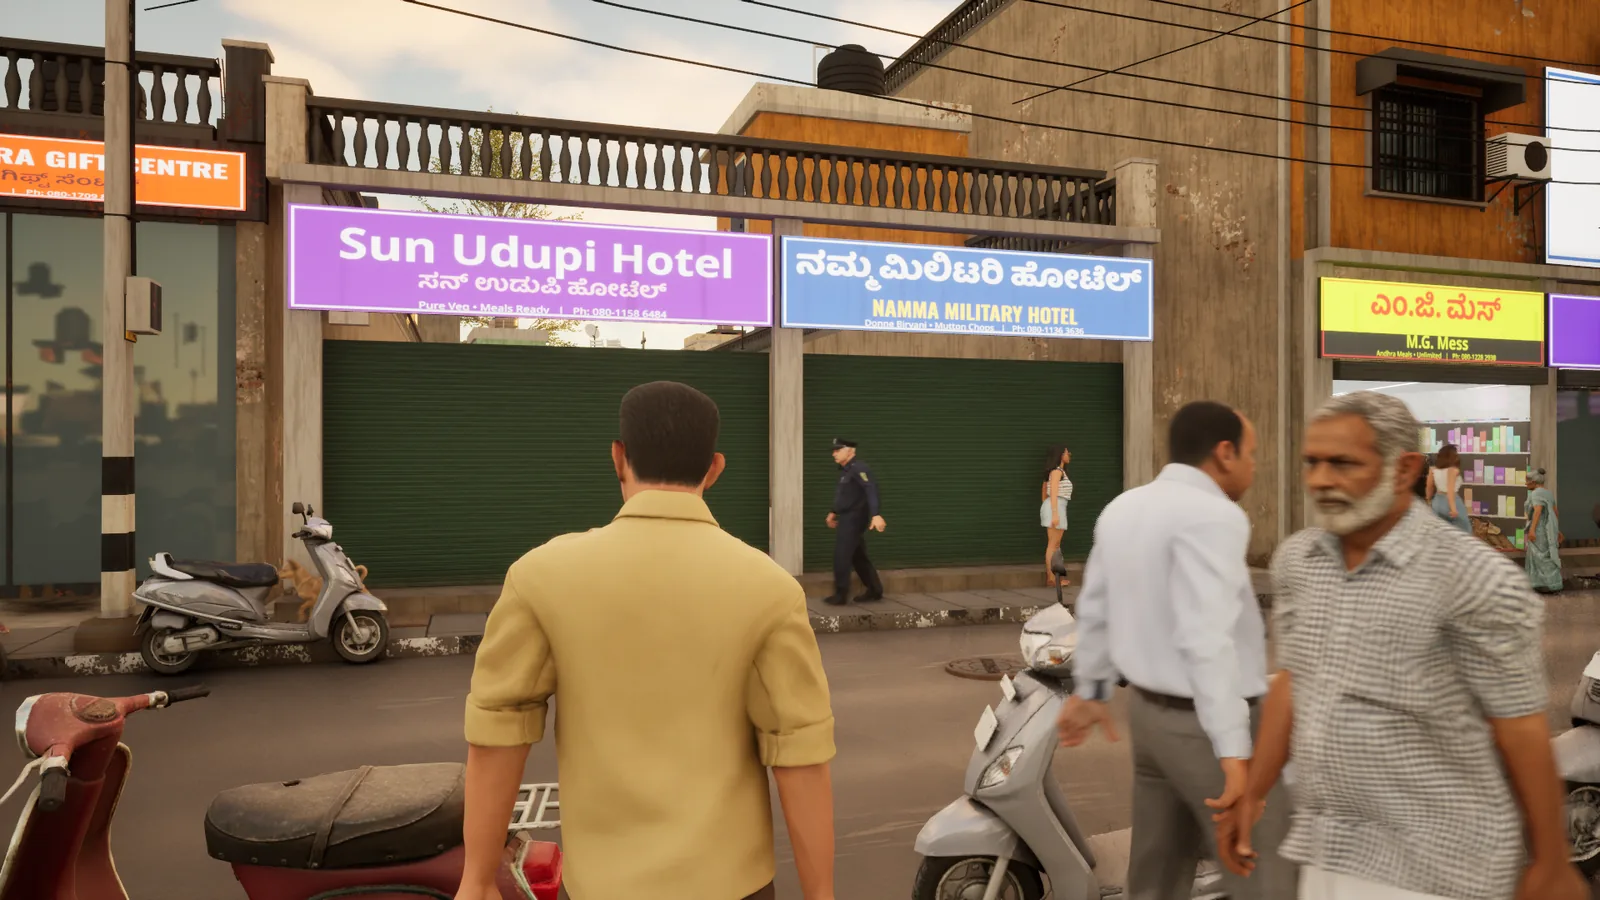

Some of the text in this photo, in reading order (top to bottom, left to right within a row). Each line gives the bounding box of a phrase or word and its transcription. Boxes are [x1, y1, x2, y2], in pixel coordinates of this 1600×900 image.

[46, 151, 104, 171] GIFT
[135, 157, 229, 180] ENTRE
[338, 226, 733, 280] Sun Udupi Hotel
[418, 271, 668, 299] ಸನ್ ಉಡುಪಿ ಹೋಟೆಲ್
[796, 249, 1142, 293] ನಮ್ಮ ಮಿಲಿಟರಿ ಹೋಟೆಲ್
[418, 301, 446, 310] Pure
[480, 303, 514, 313] Meals
[516, 304, 550, 315] Ready
[573, 307, 590, 316] Ph:
[592, 308, 640, 318] 080-1158
[641, 309, 668, 319] 6484
[872, 298, 1078, 326] NAMMA MILITARY HOTEL
[1371, 291, 1502, 321] ಎಂ.ಜಿ. ಮೆಸ್
[864, 319, 894, 328] Donne
[934, 322, 966, 331] Mutton
[968, 323, 995, 333] Chops
[1012, 325, 1025, 334] Ph:
[1397, 350, 1413, 358] Meals
[1406, 334, 1469, 351] M.G. Mess
